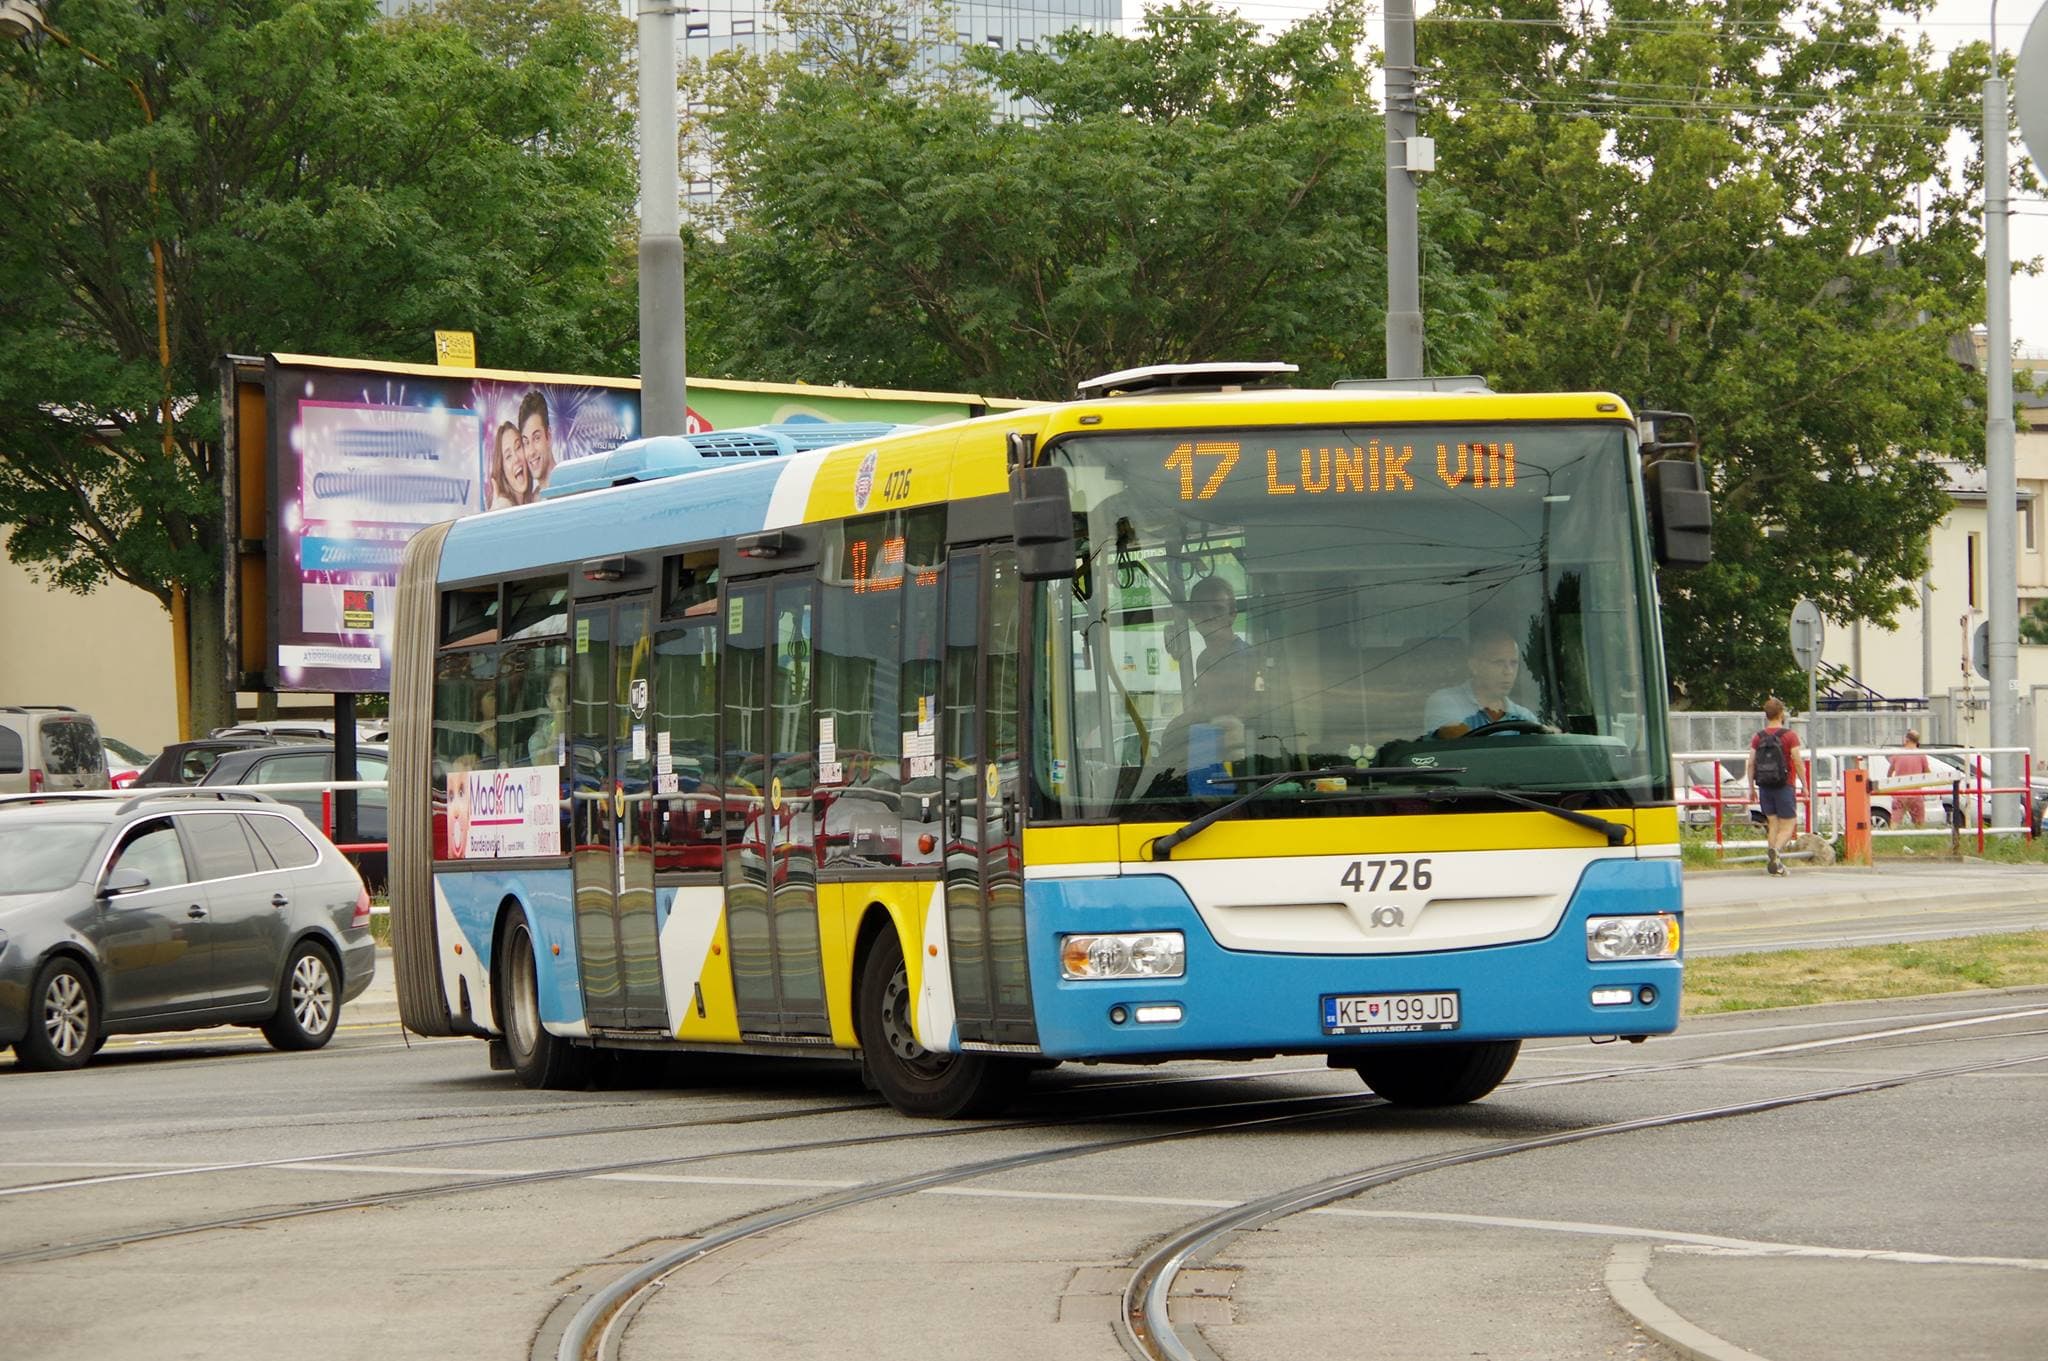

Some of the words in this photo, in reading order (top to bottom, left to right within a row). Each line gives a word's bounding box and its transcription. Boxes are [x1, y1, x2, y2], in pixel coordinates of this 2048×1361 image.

[884, 468, 912, 502] 4726
[1163, 441, 1240, 500] 17
[1436, 442, 1515, 488] VIII
[1340, 858, 1433, 893] 4726
[1339, 1001, 1368, 1023] KE
[1384, 997, 1454, 1021] 199JD
